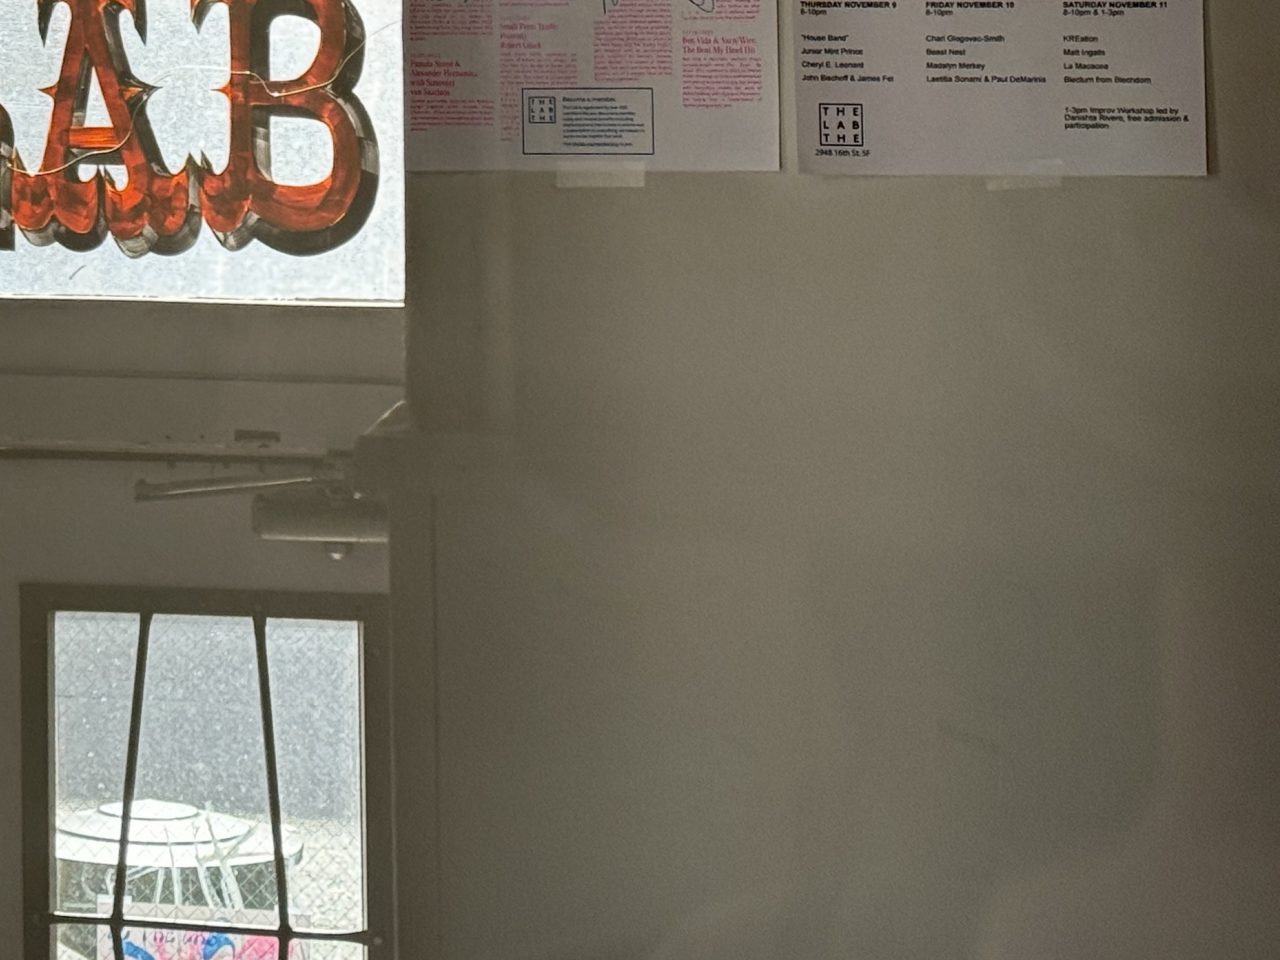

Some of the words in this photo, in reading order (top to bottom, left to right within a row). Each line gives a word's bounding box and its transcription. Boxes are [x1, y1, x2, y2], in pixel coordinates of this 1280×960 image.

[1006, 1, 1015, 9] 10
[801, 61, 824, 69] Cheryl
[821, 74, 849, 82] Bischoff
[822, 107, 859, 117] THE
[1117, 107, 1155, 115] Workshop
[1169, 107, 1179, 115] by
[823, 120, 860, 130] LAB
[823, 133, 860, 143] THE
